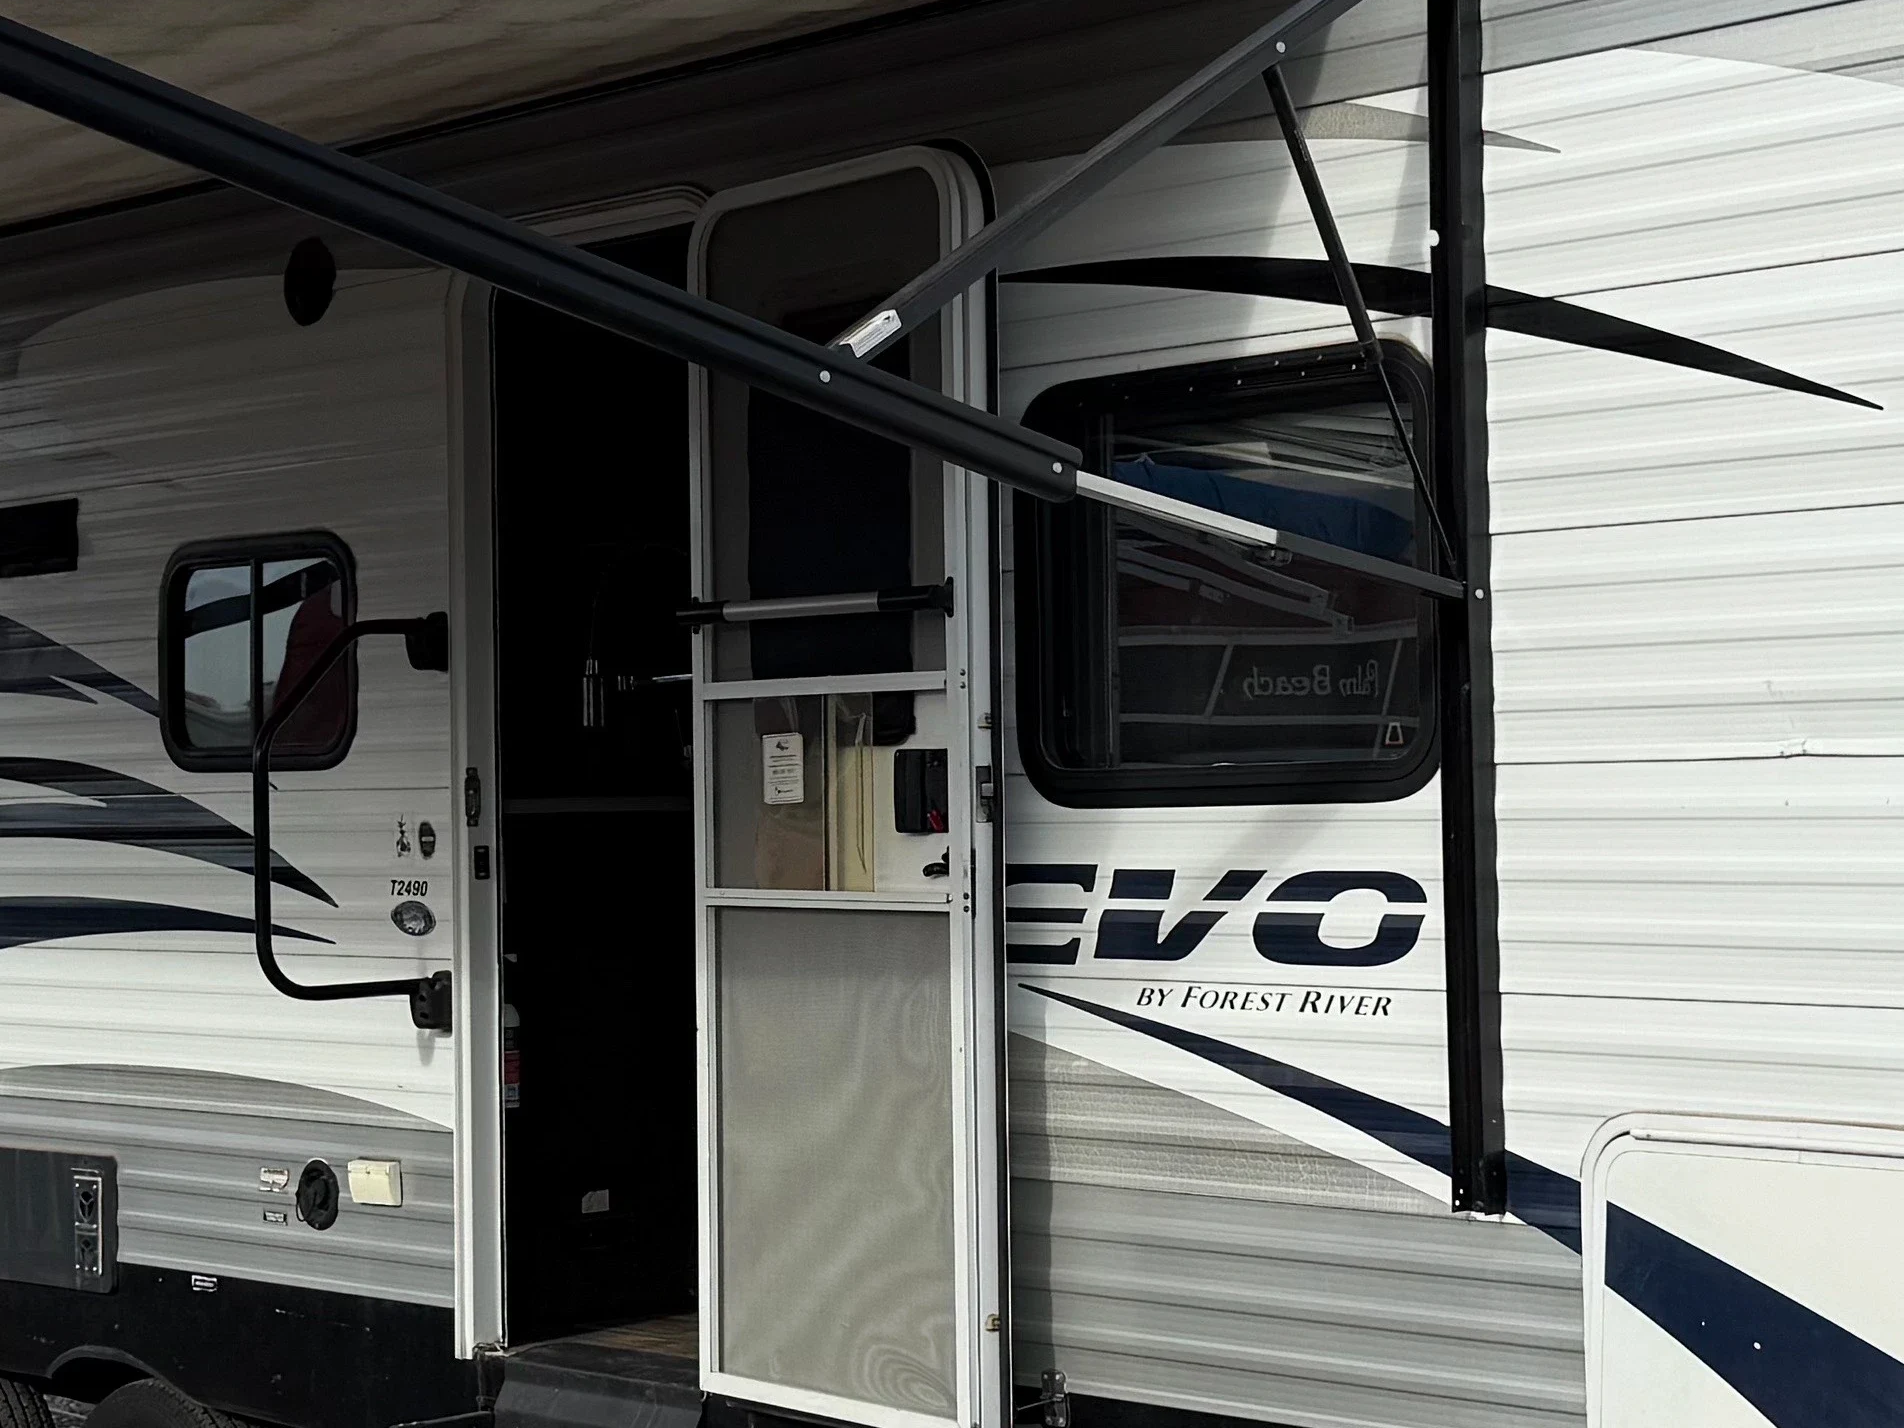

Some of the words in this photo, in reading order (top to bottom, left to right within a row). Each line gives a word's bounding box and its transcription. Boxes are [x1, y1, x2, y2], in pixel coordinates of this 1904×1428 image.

[390, 879, 428, 897] T2490
[1006, 863, 1427, 966] EVO
[1136, 986, 1173, 1008] BY
[1180, 985, 1289, 1012] FOREST
[1298, 989, 1392, 1017] RIVER
